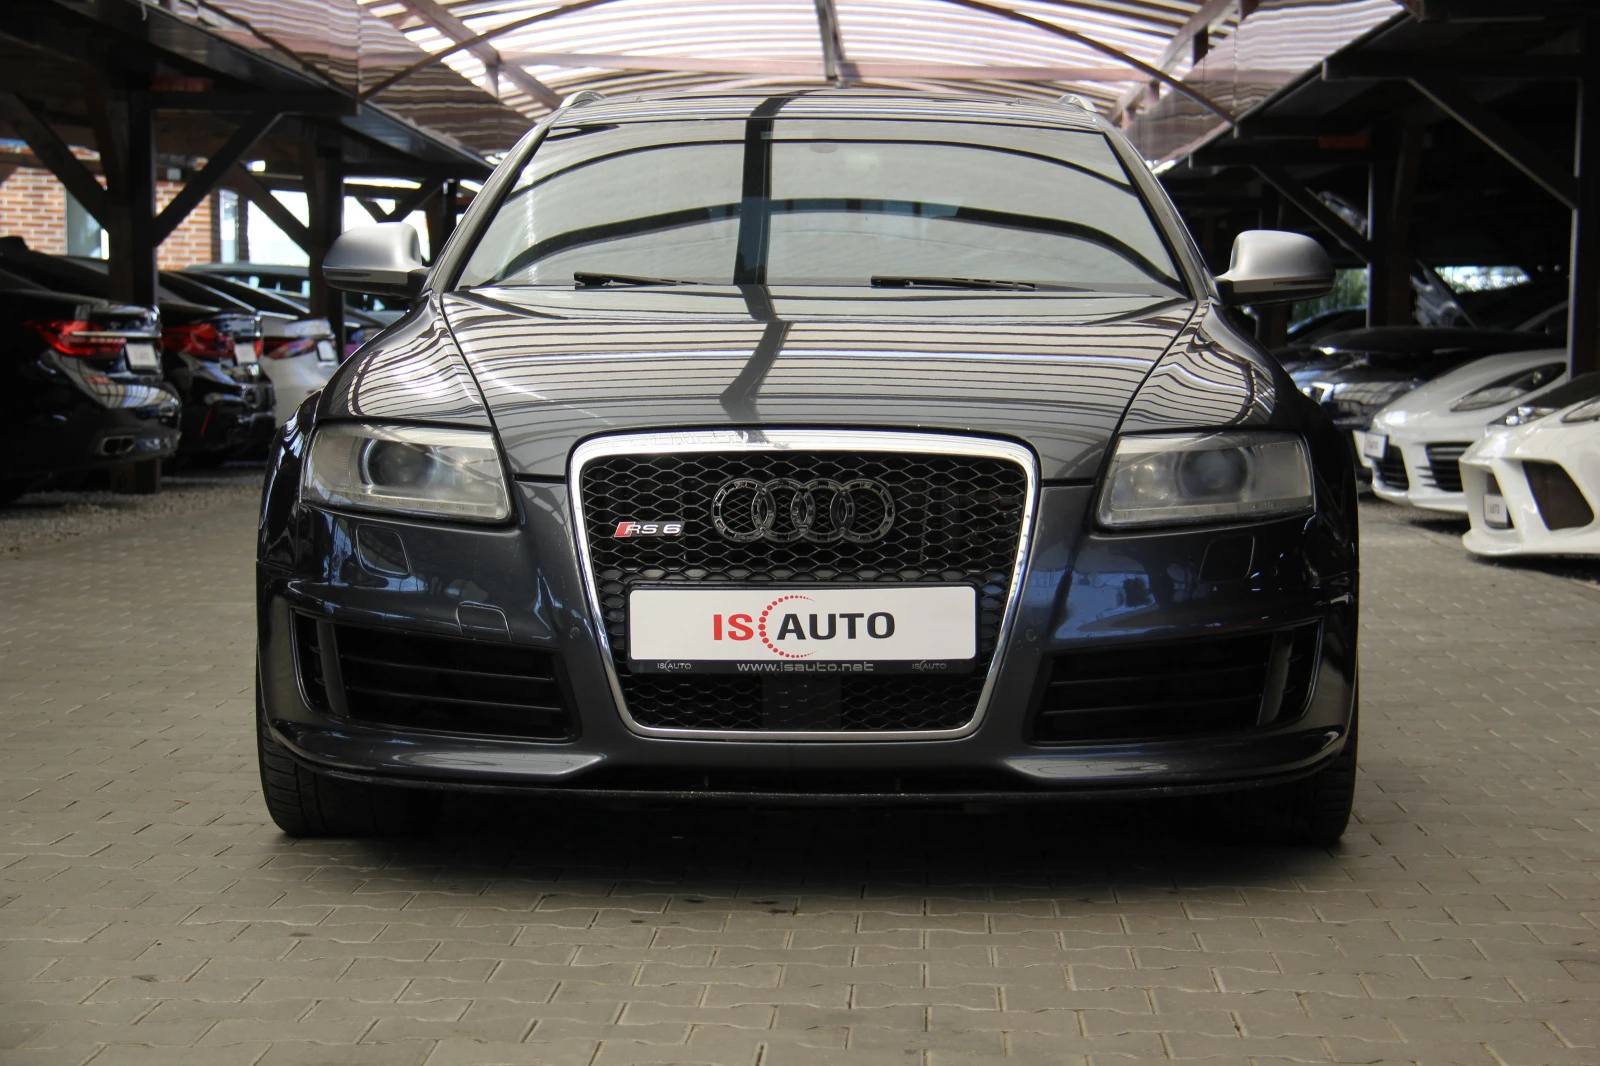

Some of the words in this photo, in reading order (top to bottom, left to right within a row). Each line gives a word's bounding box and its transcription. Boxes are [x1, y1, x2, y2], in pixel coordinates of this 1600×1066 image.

[622, 523, 659, 535] RS
[662, 524, 682, 535] 6
[713, 613, 754, 641] IS
[776, 612, 896, 641] AUTO
[667, 662, 692, 670] AUTO
[736, 661, 874, 672] www.isauto.net
[922, 662, 947, 670] AUTO
